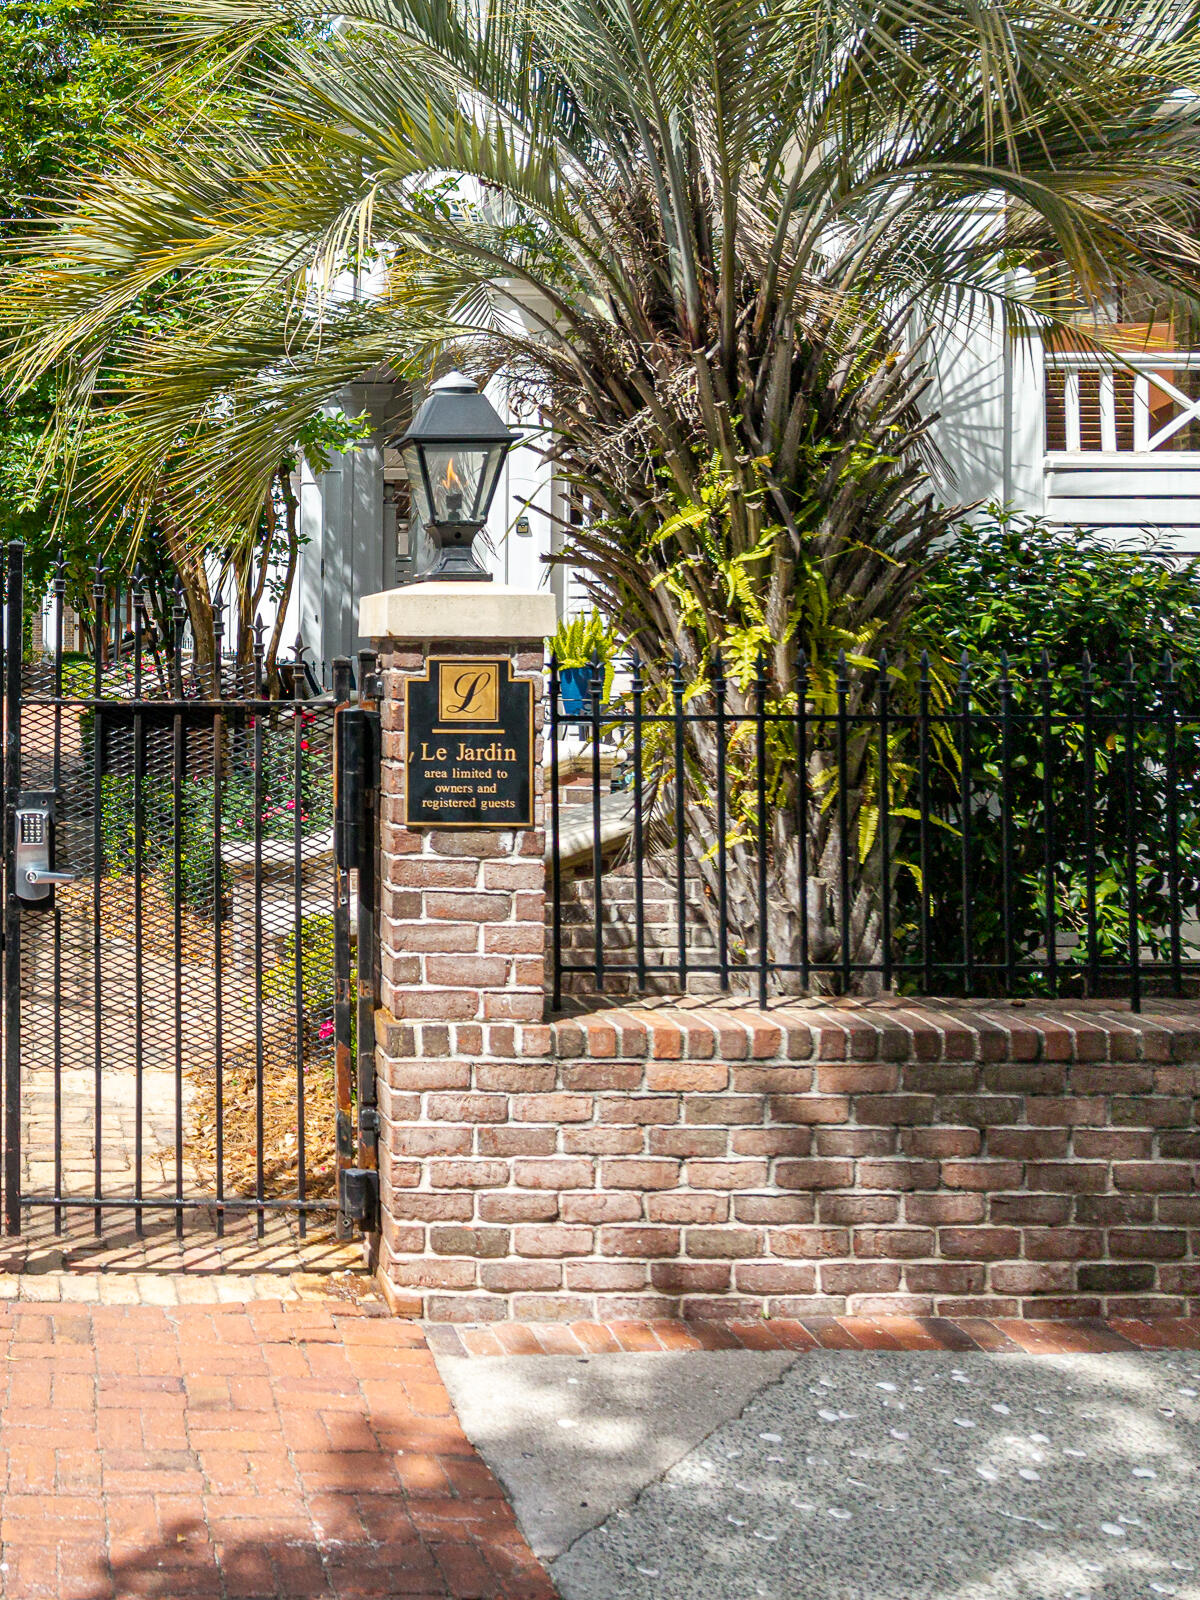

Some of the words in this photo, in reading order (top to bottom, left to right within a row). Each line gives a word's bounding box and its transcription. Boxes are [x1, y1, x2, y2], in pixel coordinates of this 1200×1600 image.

[446, 672, 491, 713] L
[420, 742, 448, 762] Le
[456, 742, 517, 762] Jardin
[424, 770, 448, 779] area
[452, 767, 492, 779] limited
[496, 769, 509, 779] to
[434, 785, 473, 794] owners
[477, 782, 497, 794] and
[422, 797, 477, 811] registered
[480, 799, 516, 811] guests
